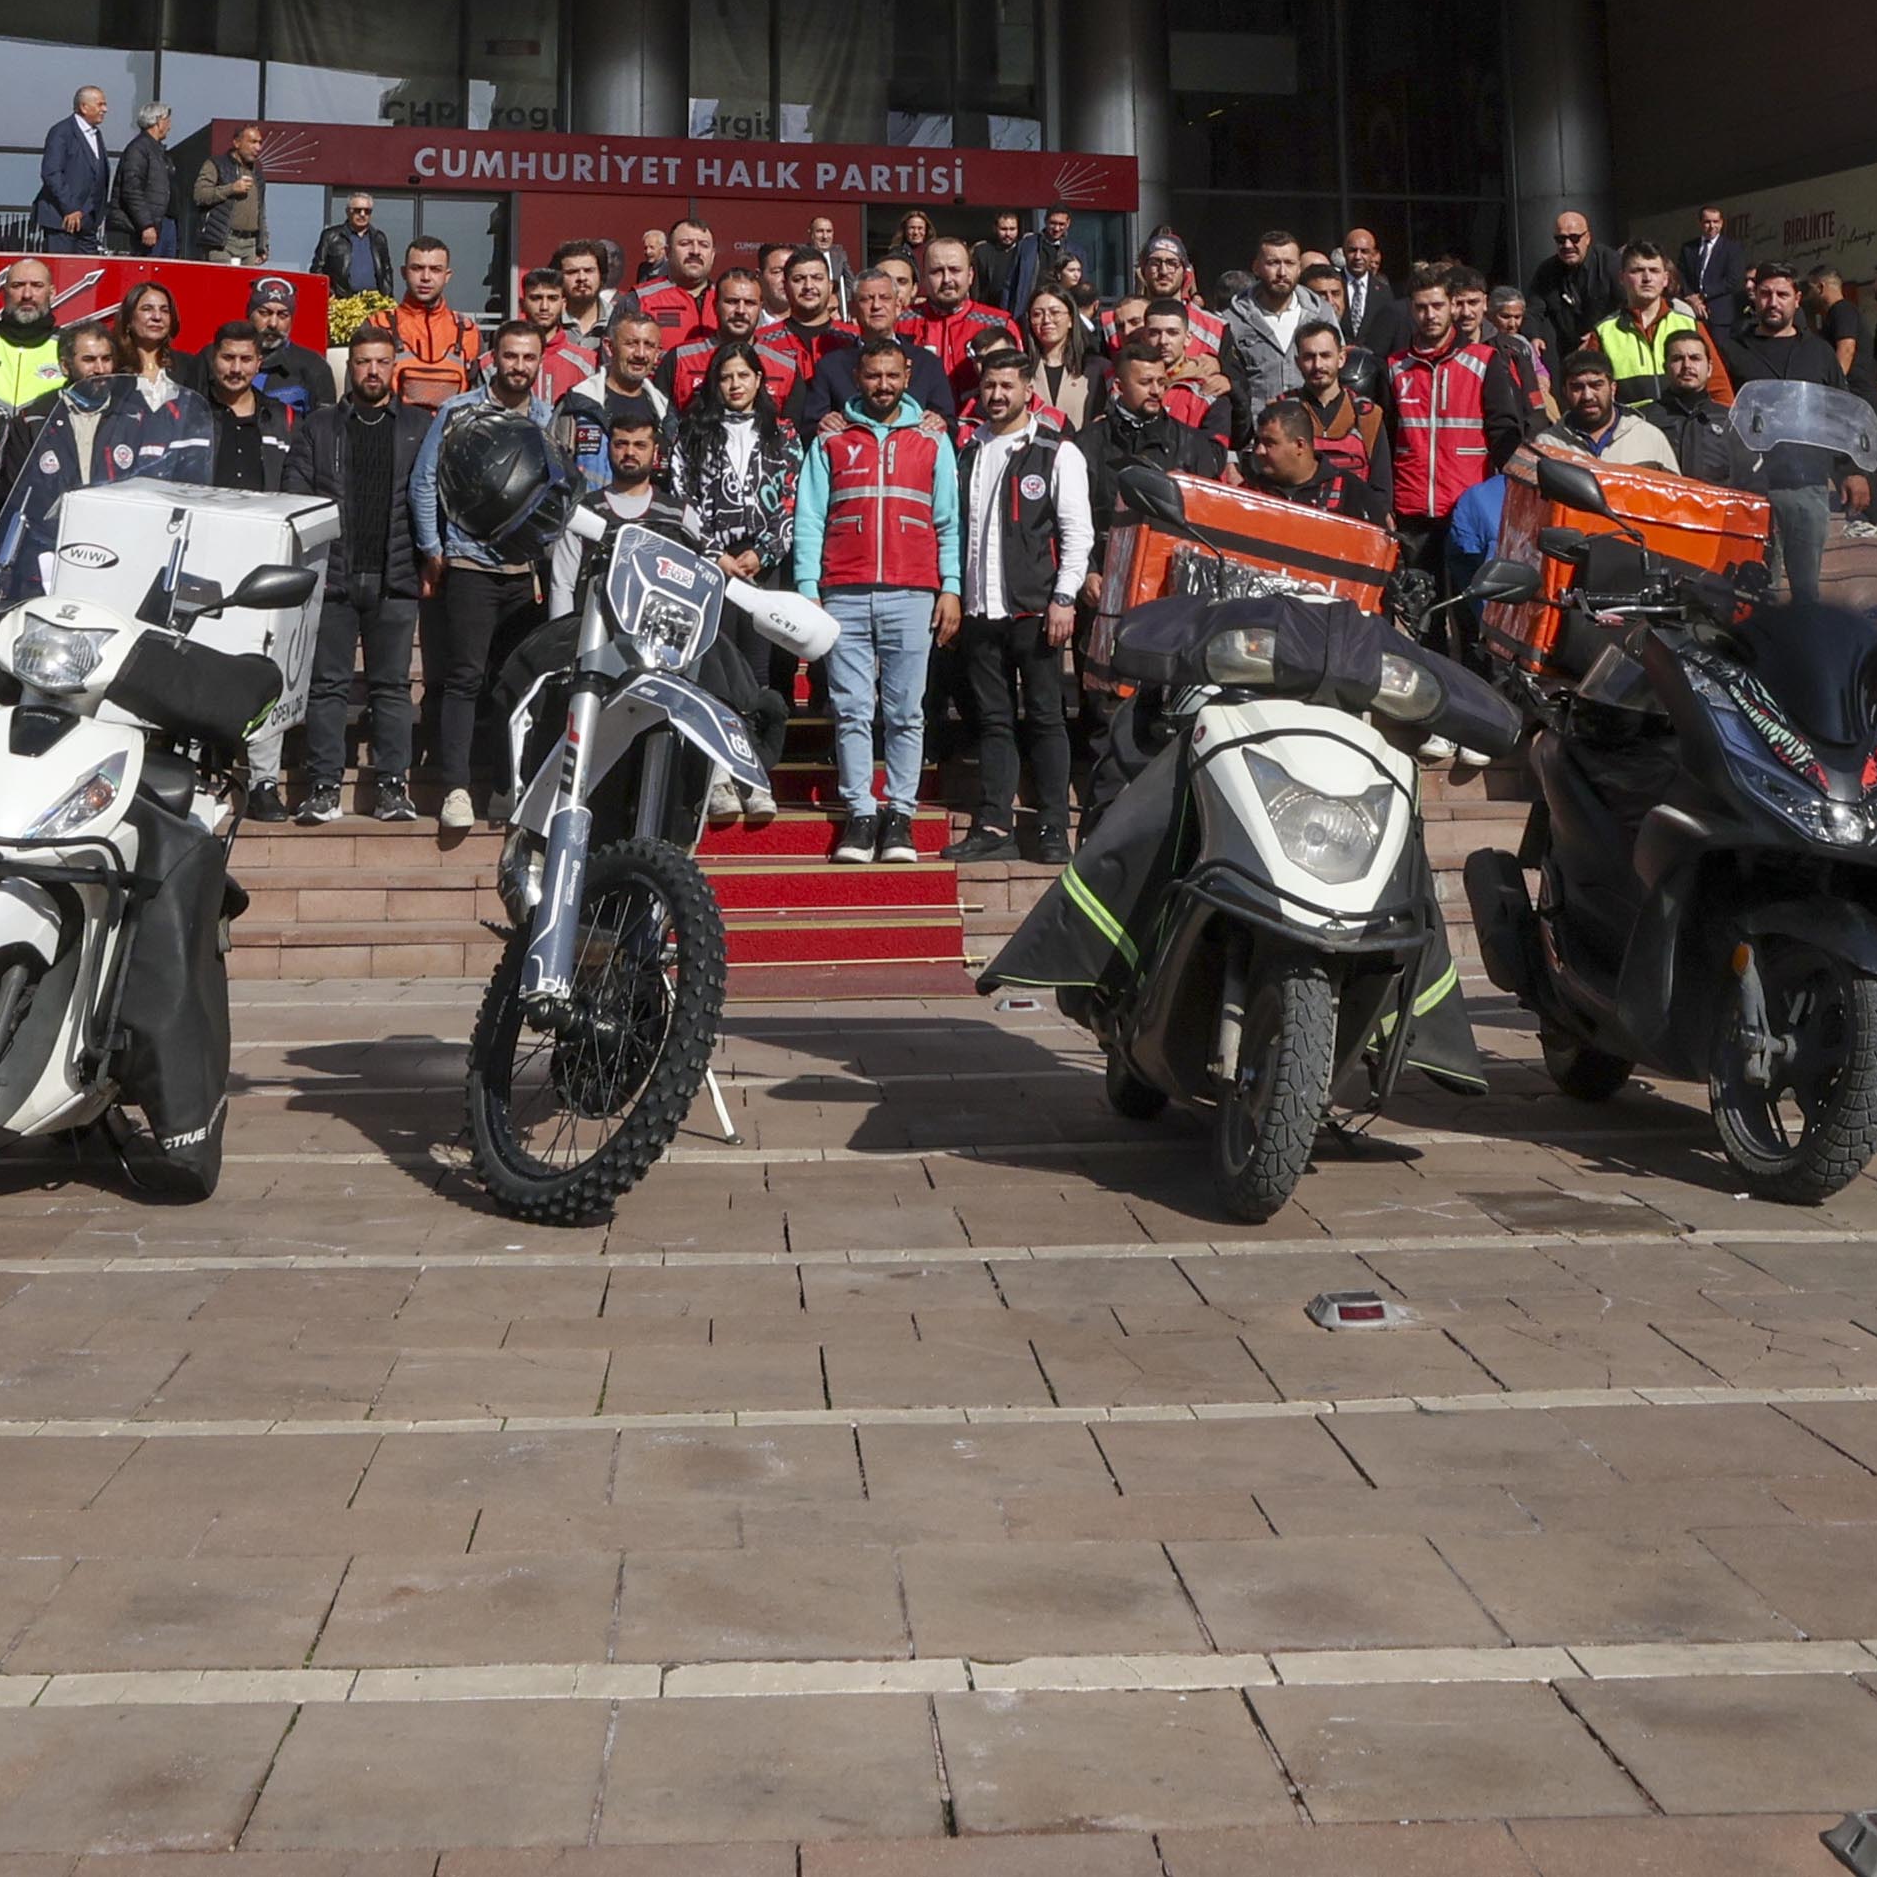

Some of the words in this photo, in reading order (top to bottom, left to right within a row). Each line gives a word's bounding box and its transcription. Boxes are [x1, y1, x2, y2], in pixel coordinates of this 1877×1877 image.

[414, 144, 681, 186] CUMHURİYET
[696, 158, 800, 189] HALK
[816, 157, 963, 195] PARTİSİ
[162, 1126, 207, 1151] CTIVE
